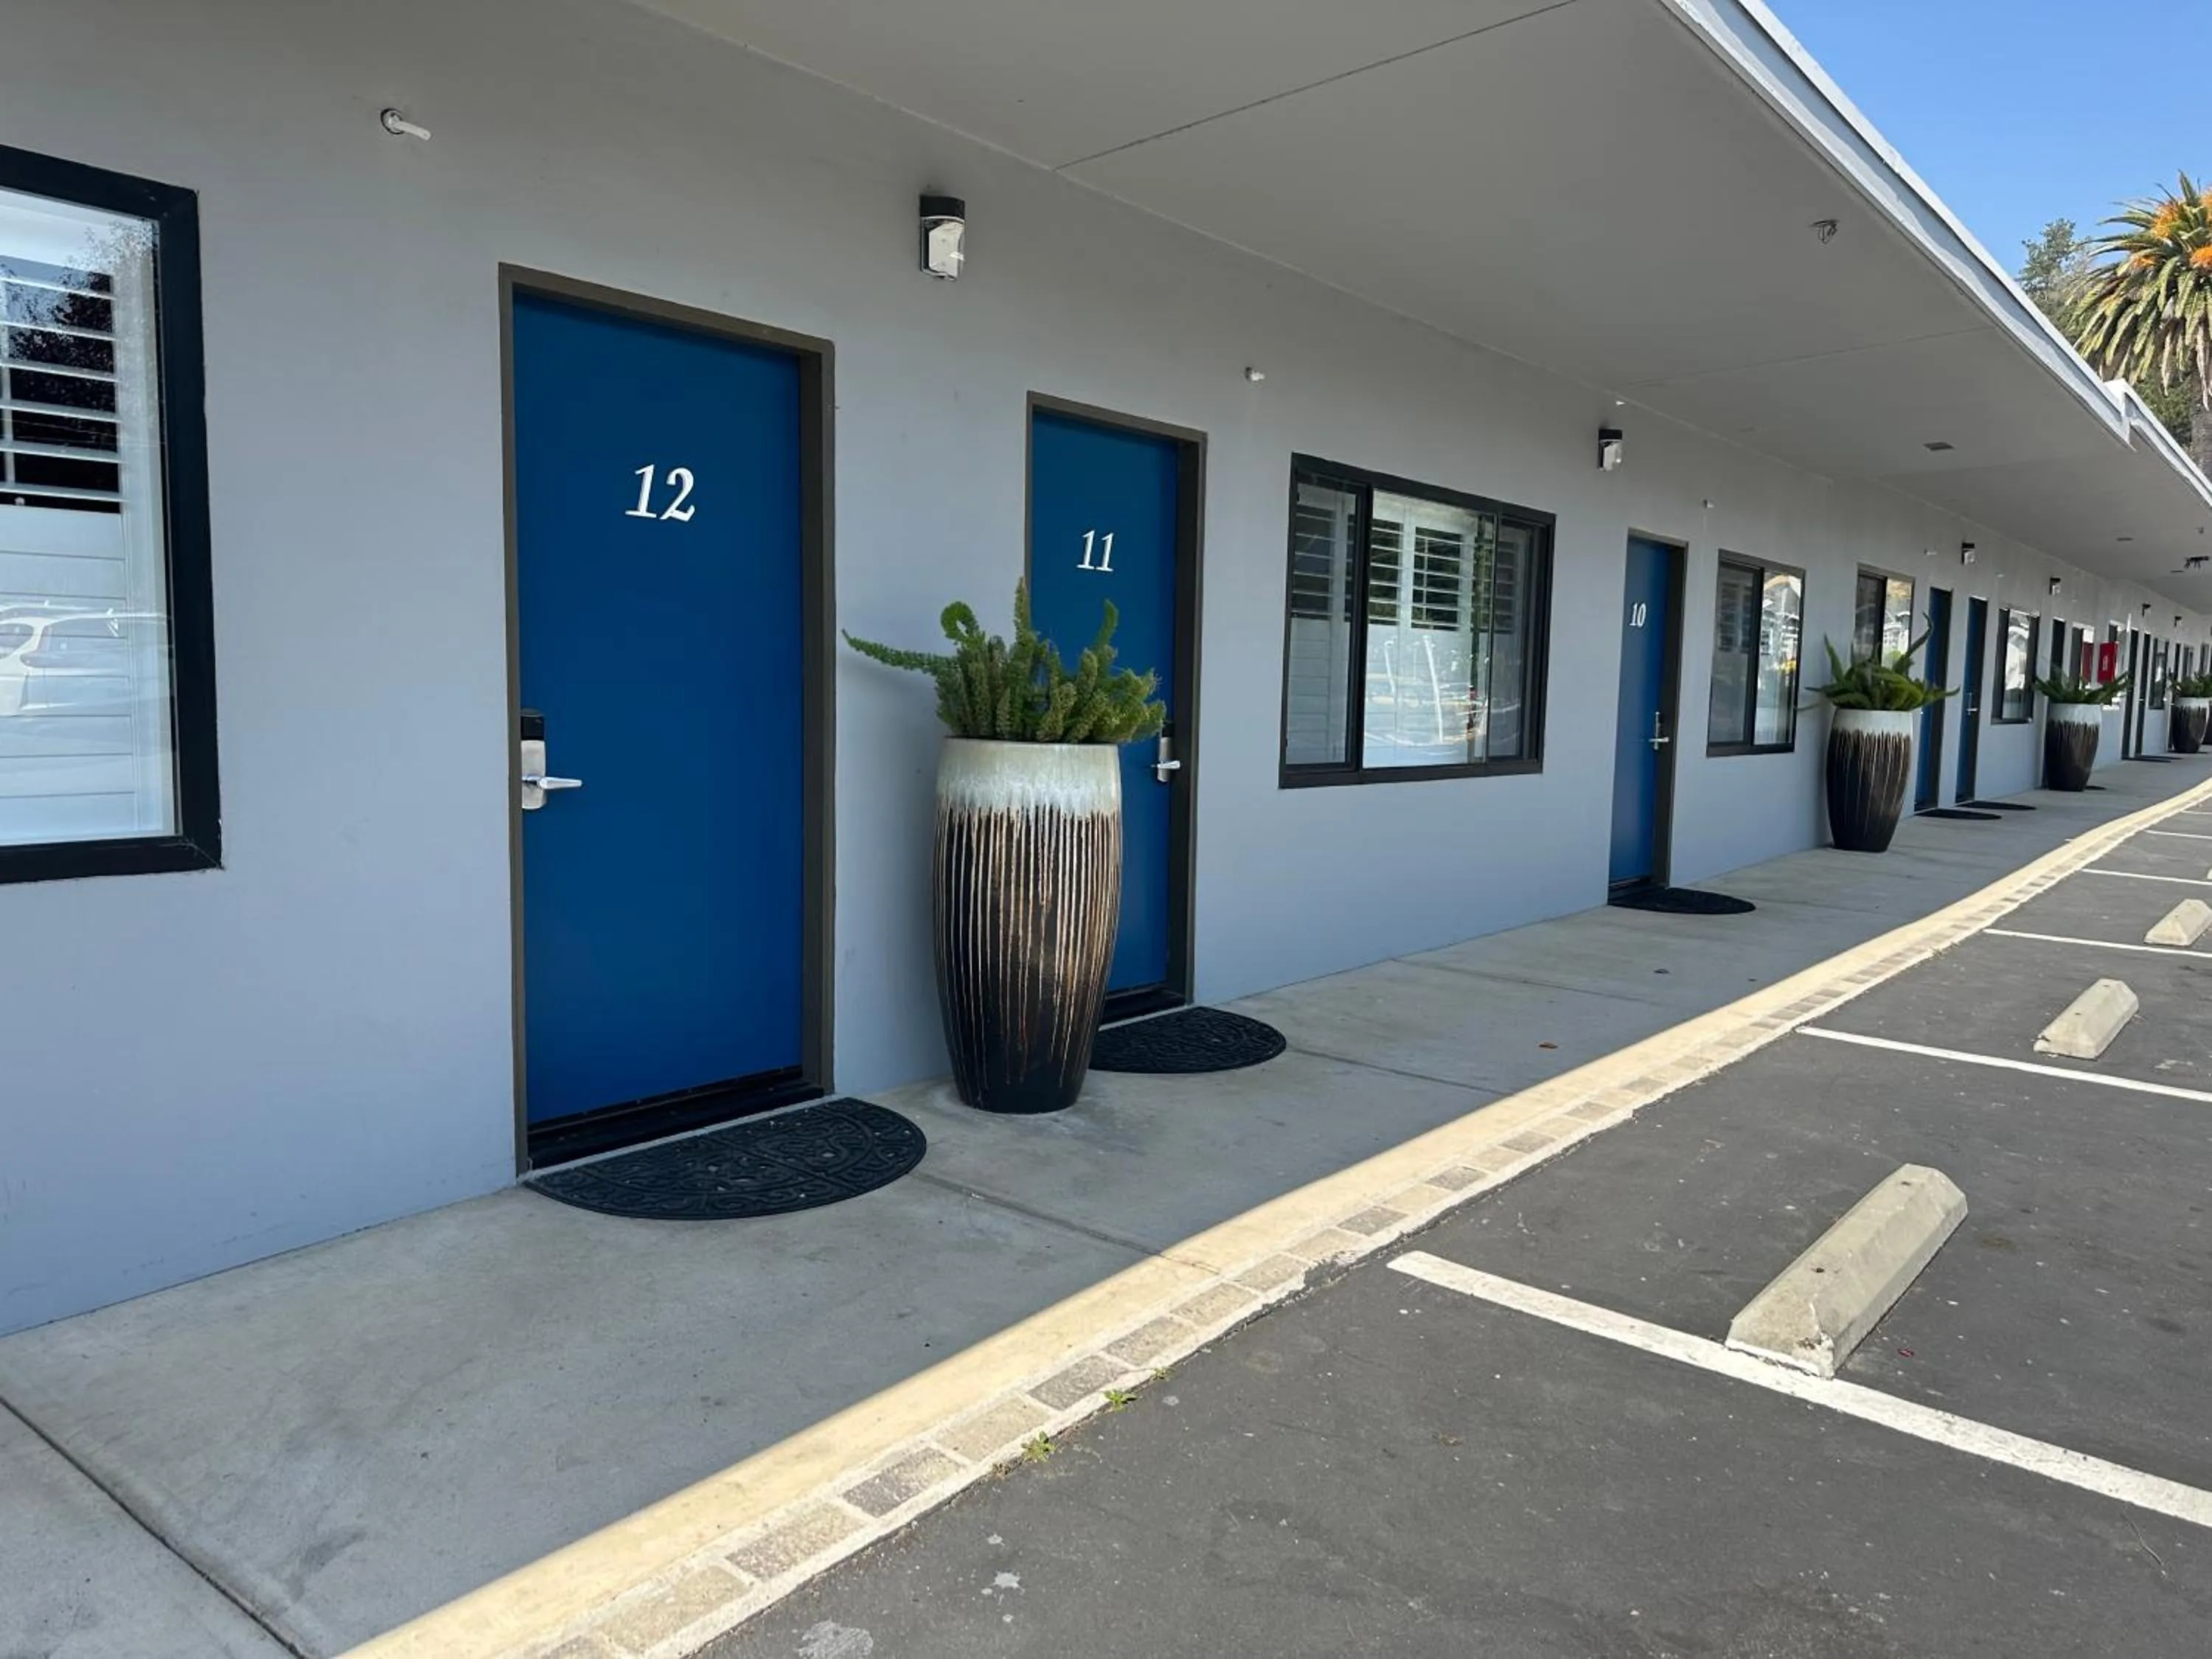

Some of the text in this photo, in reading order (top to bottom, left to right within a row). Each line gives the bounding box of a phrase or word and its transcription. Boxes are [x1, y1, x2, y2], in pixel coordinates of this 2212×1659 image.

[625, 464, 695, 522] 12
[1077, 530, 1114, 571] 11
[1629, 602, 1646, 627] 10
